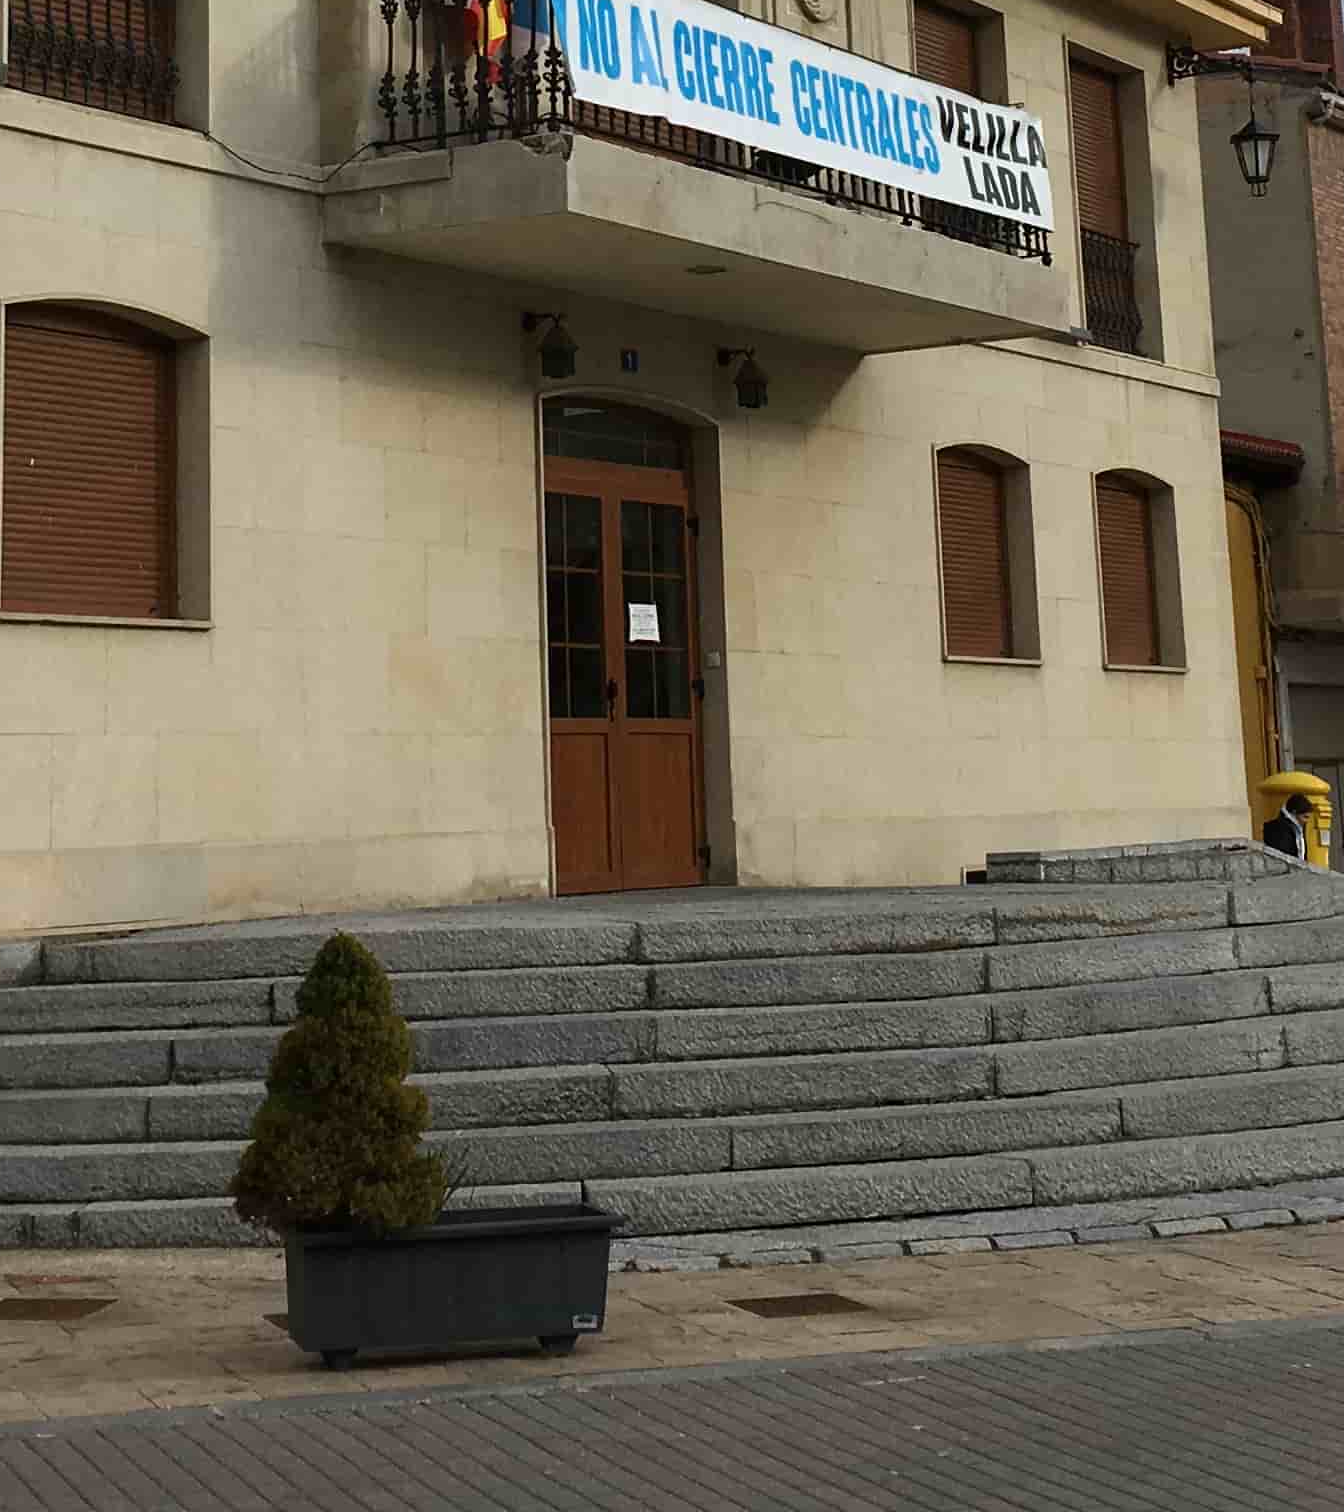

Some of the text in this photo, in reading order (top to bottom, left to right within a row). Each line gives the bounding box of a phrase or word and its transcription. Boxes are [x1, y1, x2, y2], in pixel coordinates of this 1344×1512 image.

[630, 5, 669, 93] AL
[674, 19, 780, 126] CIERRE
[790, 59, 941, 174] CENTRALES
[936, 95, 1048, 169] VELILLA
[963, 155, 1041, 216] LADA
